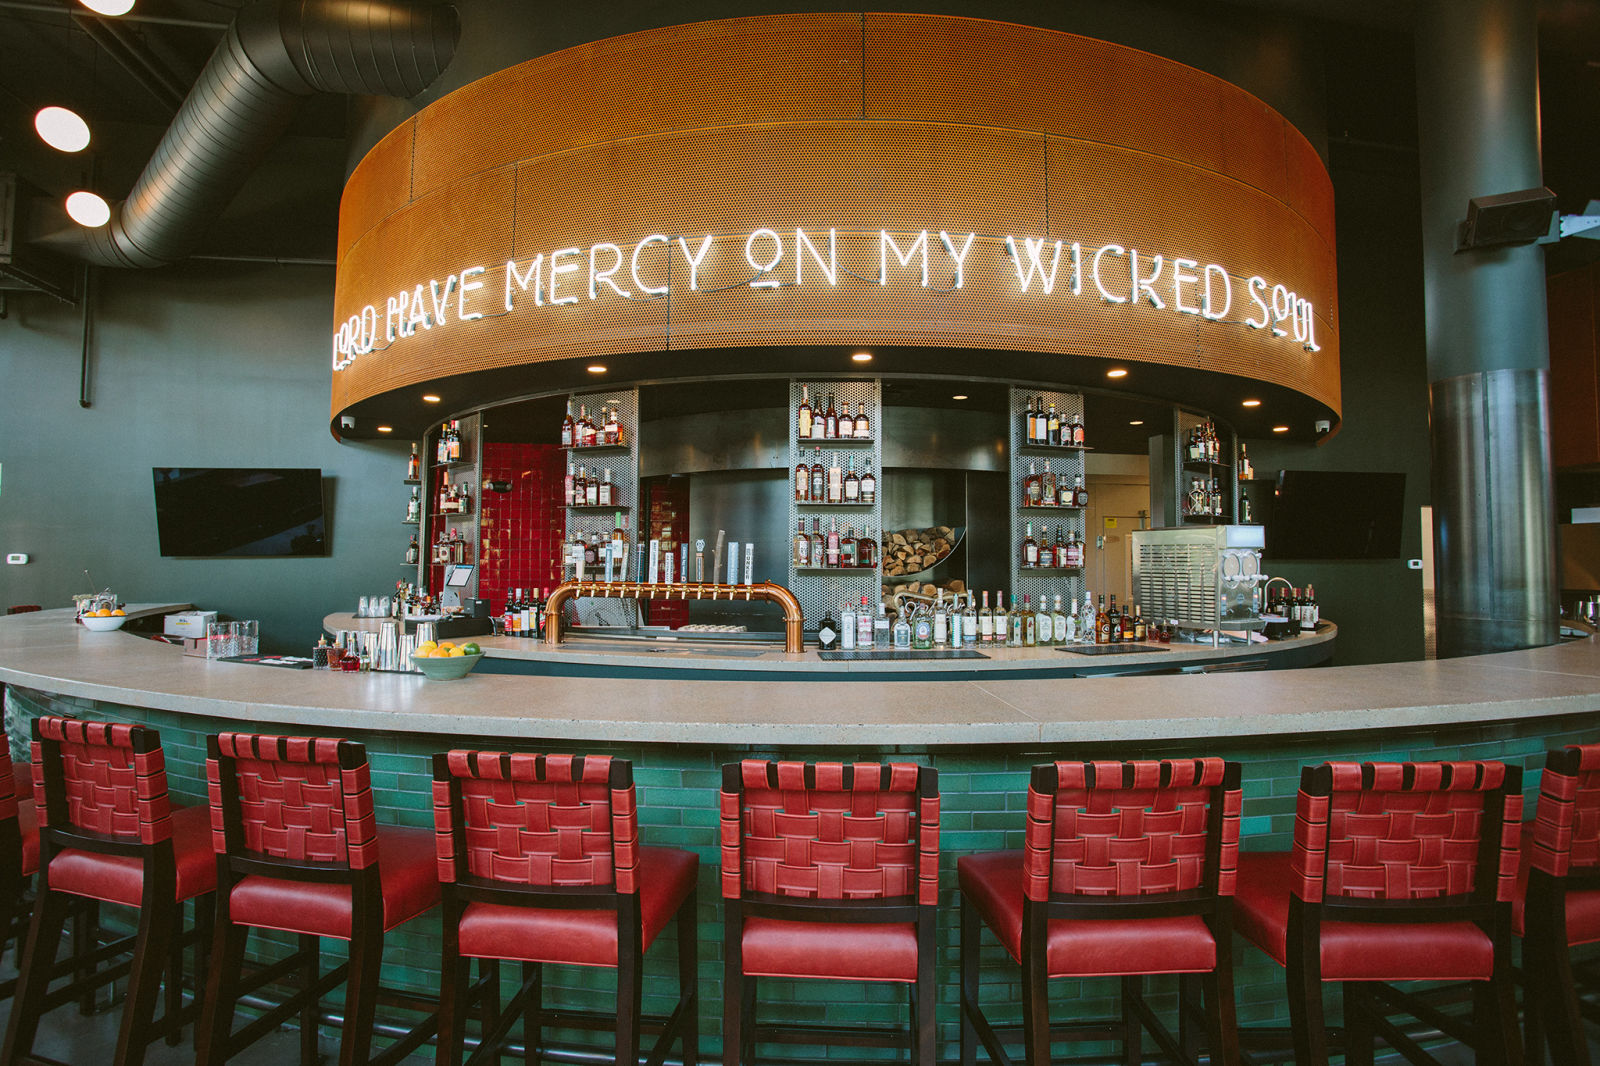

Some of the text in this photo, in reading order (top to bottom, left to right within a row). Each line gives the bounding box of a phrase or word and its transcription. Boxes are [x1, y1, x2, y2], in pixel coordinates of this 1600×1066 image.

[332, 305, 376, 371] LORD
[386, 267, 485, 342] HAVE
[505, 234, 713, 312] MERCY
[745, 227, 836, 289] ON
[879, 228, 976, 289] MY
[1005, 235, 1232, 320] WICKED
